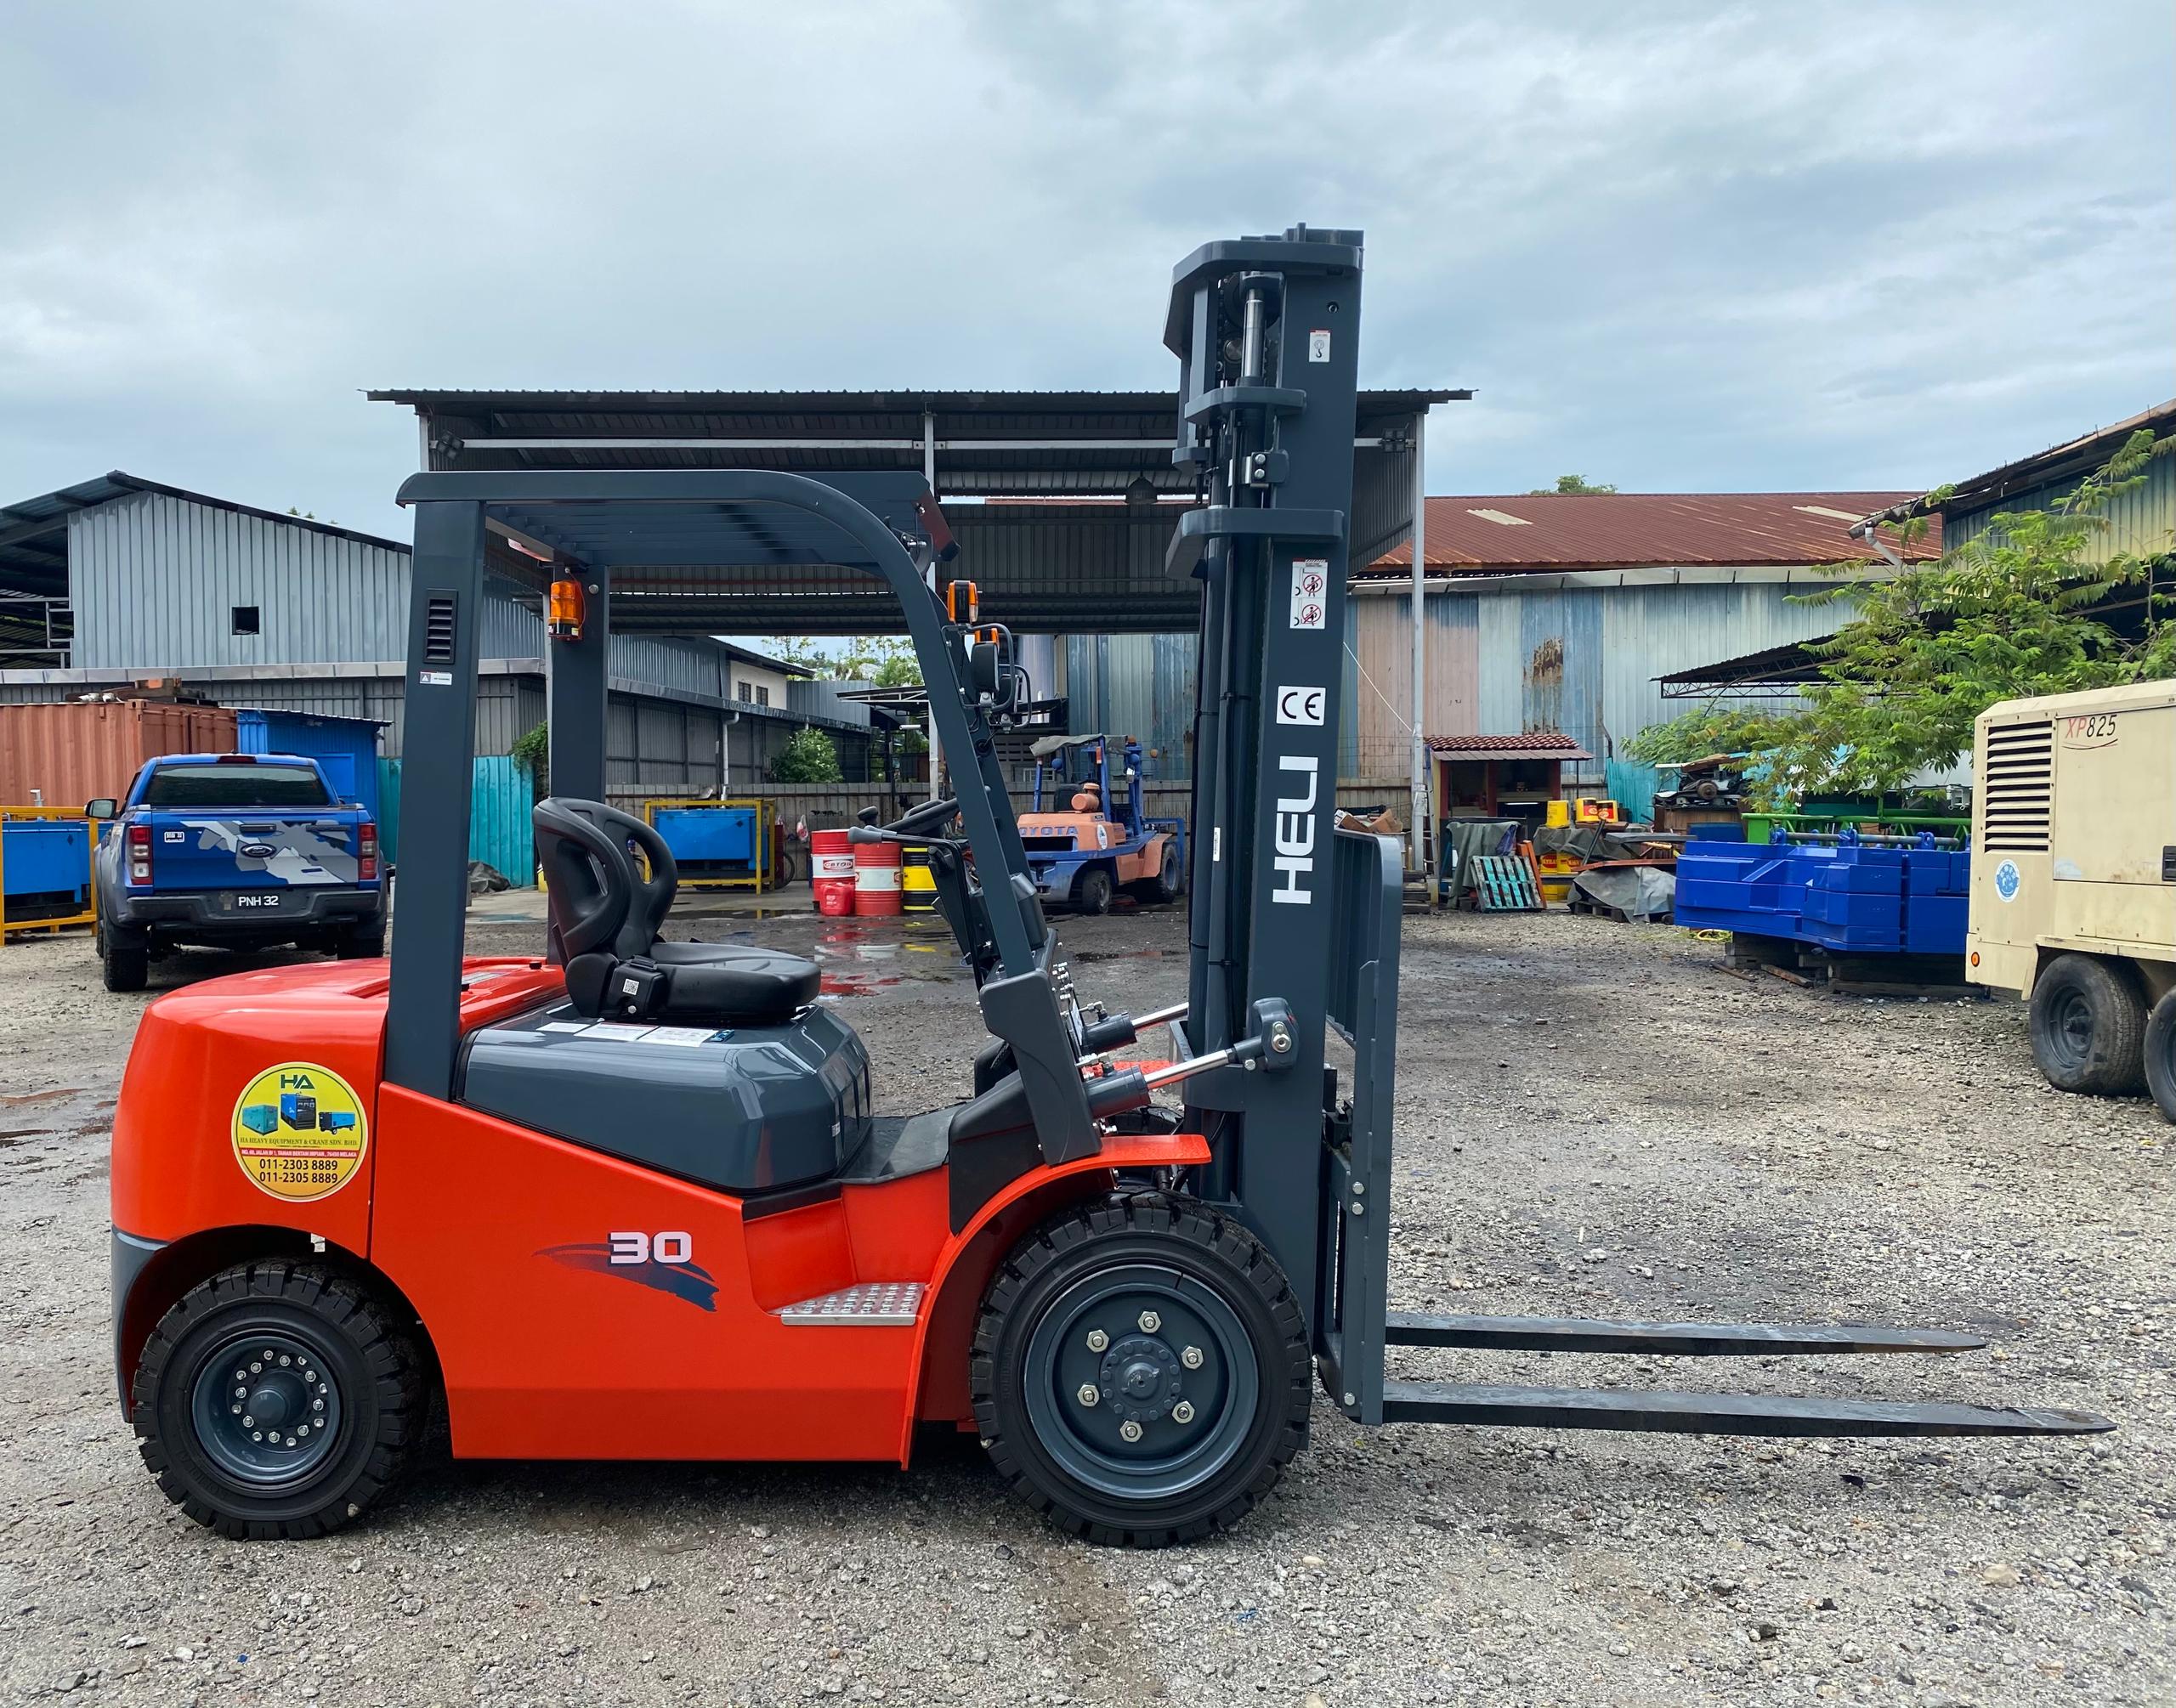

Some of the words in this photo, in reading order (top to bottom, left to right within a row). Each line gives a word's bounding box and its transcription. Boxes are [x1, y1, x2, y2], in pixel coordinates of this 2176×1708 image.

[2066, 715, 2117, 738] XP825
[1019, 826, 1079, 836] OYOTA
[1272, 756, 1318, 904] HELI
[238, 896, 262, 907] PNH
[263, 896, 279, 906] 32
[280, 1074, 315, 1089] HA
[259, 1158, 309, 1170] 011-2303
[311, 1160, 337, 1170] 8889
[259, 1172, 309, 1183] 011-2305
[311, 1173, 337, 1183] 8889
[609, 1230, 692, 1264] 30
